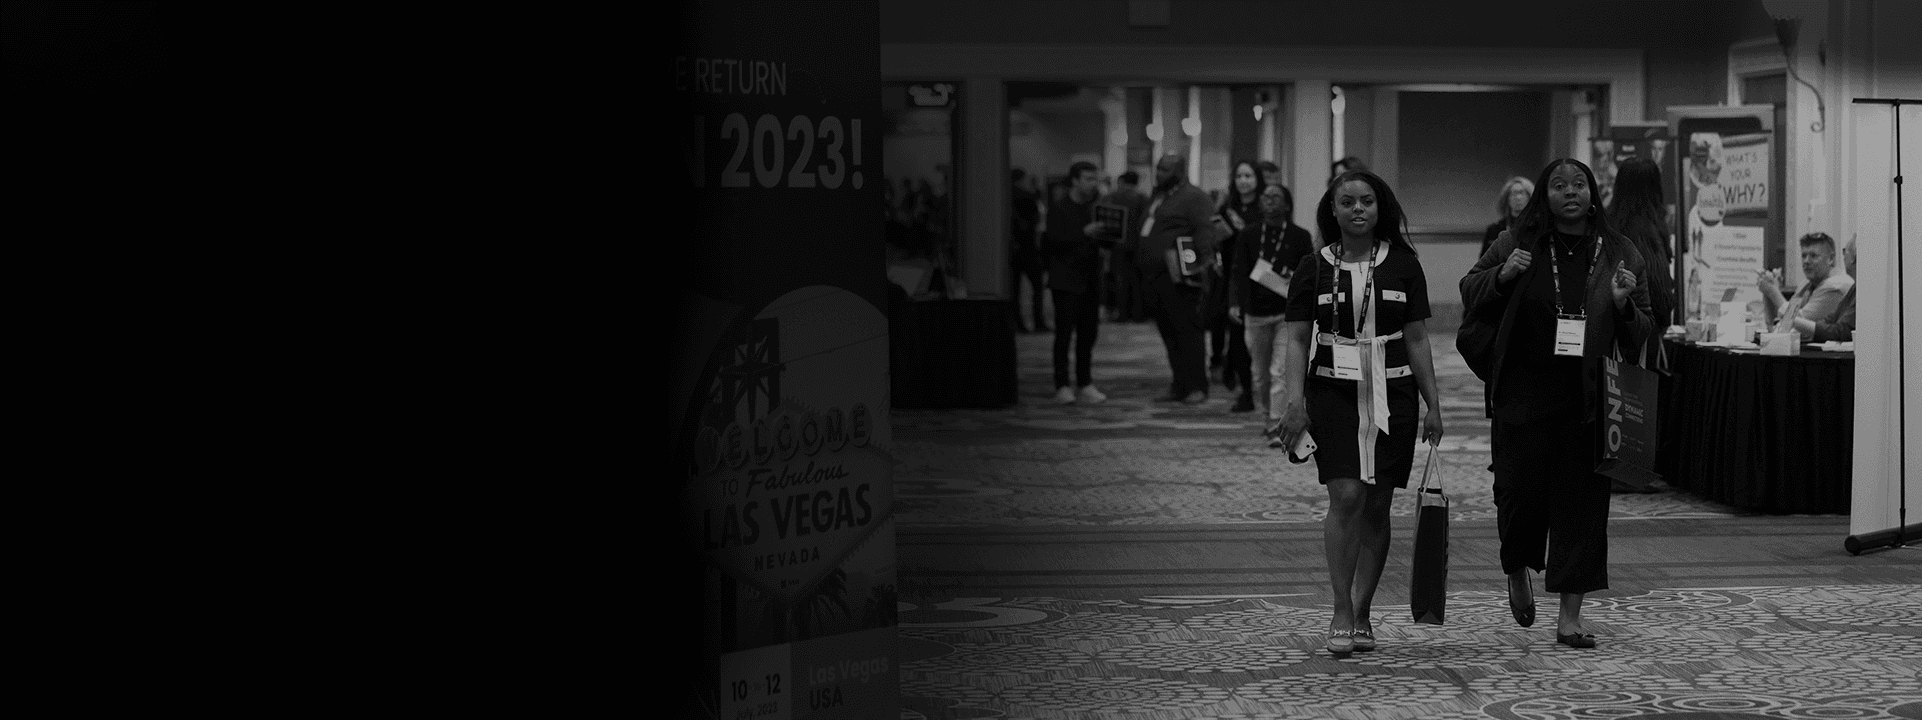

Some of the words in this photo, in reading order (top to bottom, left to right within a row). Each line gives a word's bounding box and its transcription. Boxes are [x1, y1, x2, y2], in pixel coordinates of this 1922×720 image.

[695, 57, 787, 96] RETURN
[720, 111, 864, 190] 2023!
[1729, 168, 1752, 181] YOUR
[1605, 355, 1623, 459] ONFE
[719, 478, 739, 498] TO
[745, 461, 850, 499] Fabulous
[703, 501, 760, 550] LAS
[770, 483, 873, 540] VEGAS
[754, 547, 821, 572] NEVADA
[809, 665, 836, 685] Las
[839, 656, 889, 684] Vegas
[732, 679, 748, 702] 10
[766, 673, 781, 696] 12
[809, 685, 844, 711] USA
